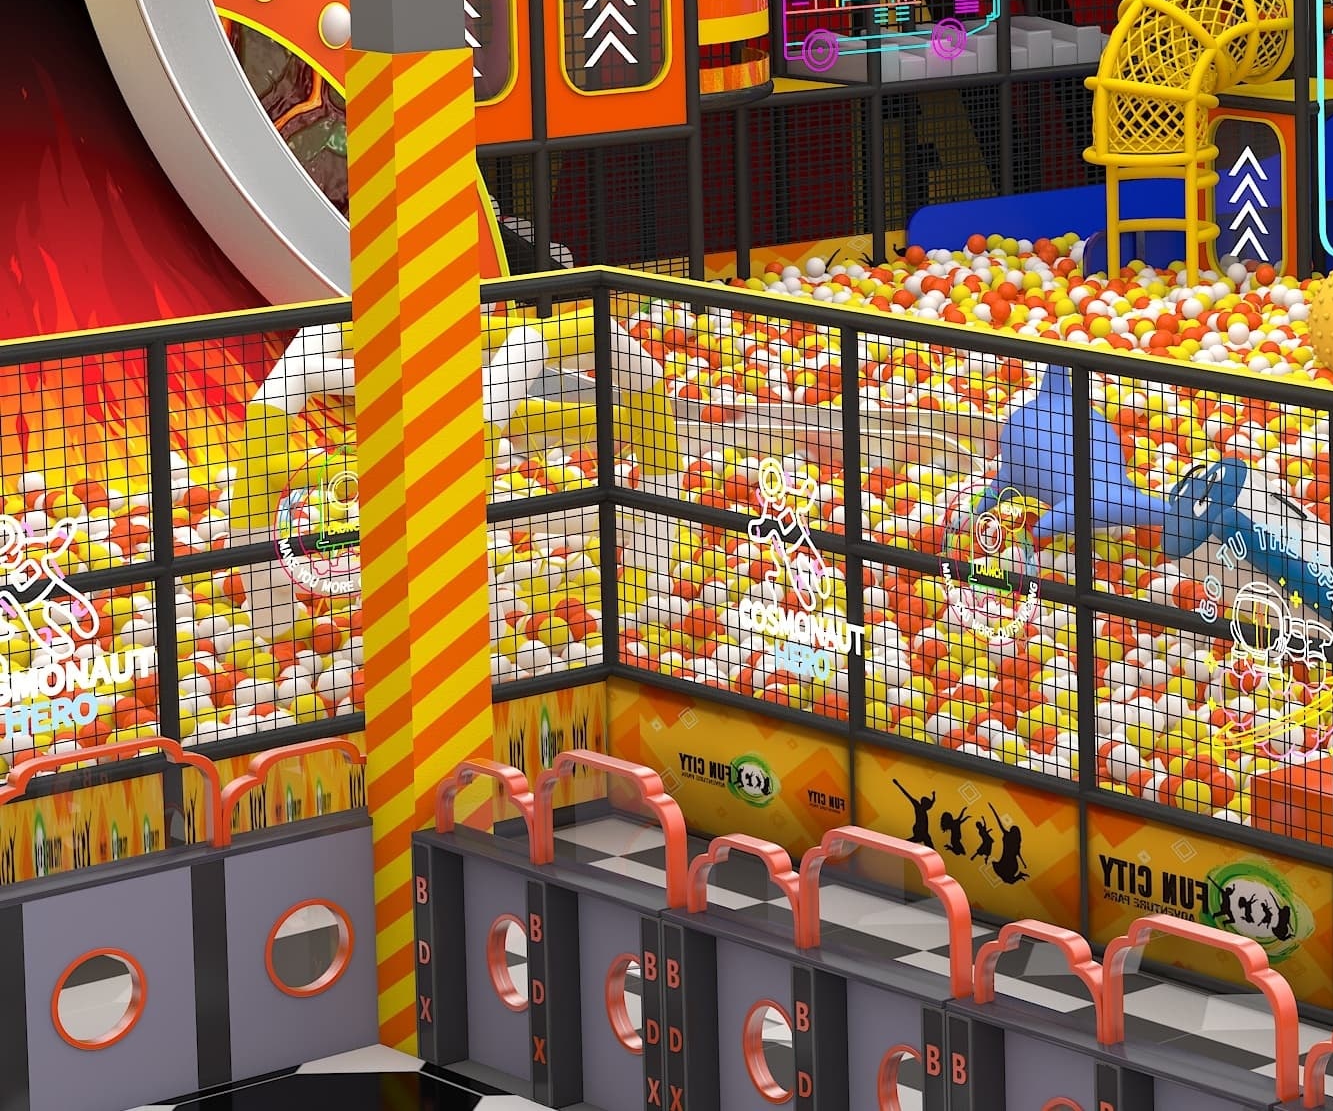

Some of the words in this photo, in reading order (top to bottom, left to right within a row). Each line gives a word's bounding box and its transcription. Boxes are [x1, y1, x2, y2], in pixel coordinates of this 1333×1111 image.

[328, 521, 360, 536] LAUNC
[298, 568, 320, 588] YOU
[321, 580, 355, 593] MORE
[1199, 575, 1222, 623] GO
[1253, 523, 1301, 559] THE
[739, 598, 864, 657] COSMONAUT
[0, 646, 156, 706] SMONAUT
[775, 638, 830, 682] HERO
[4, 693, 98, 738] HERO
